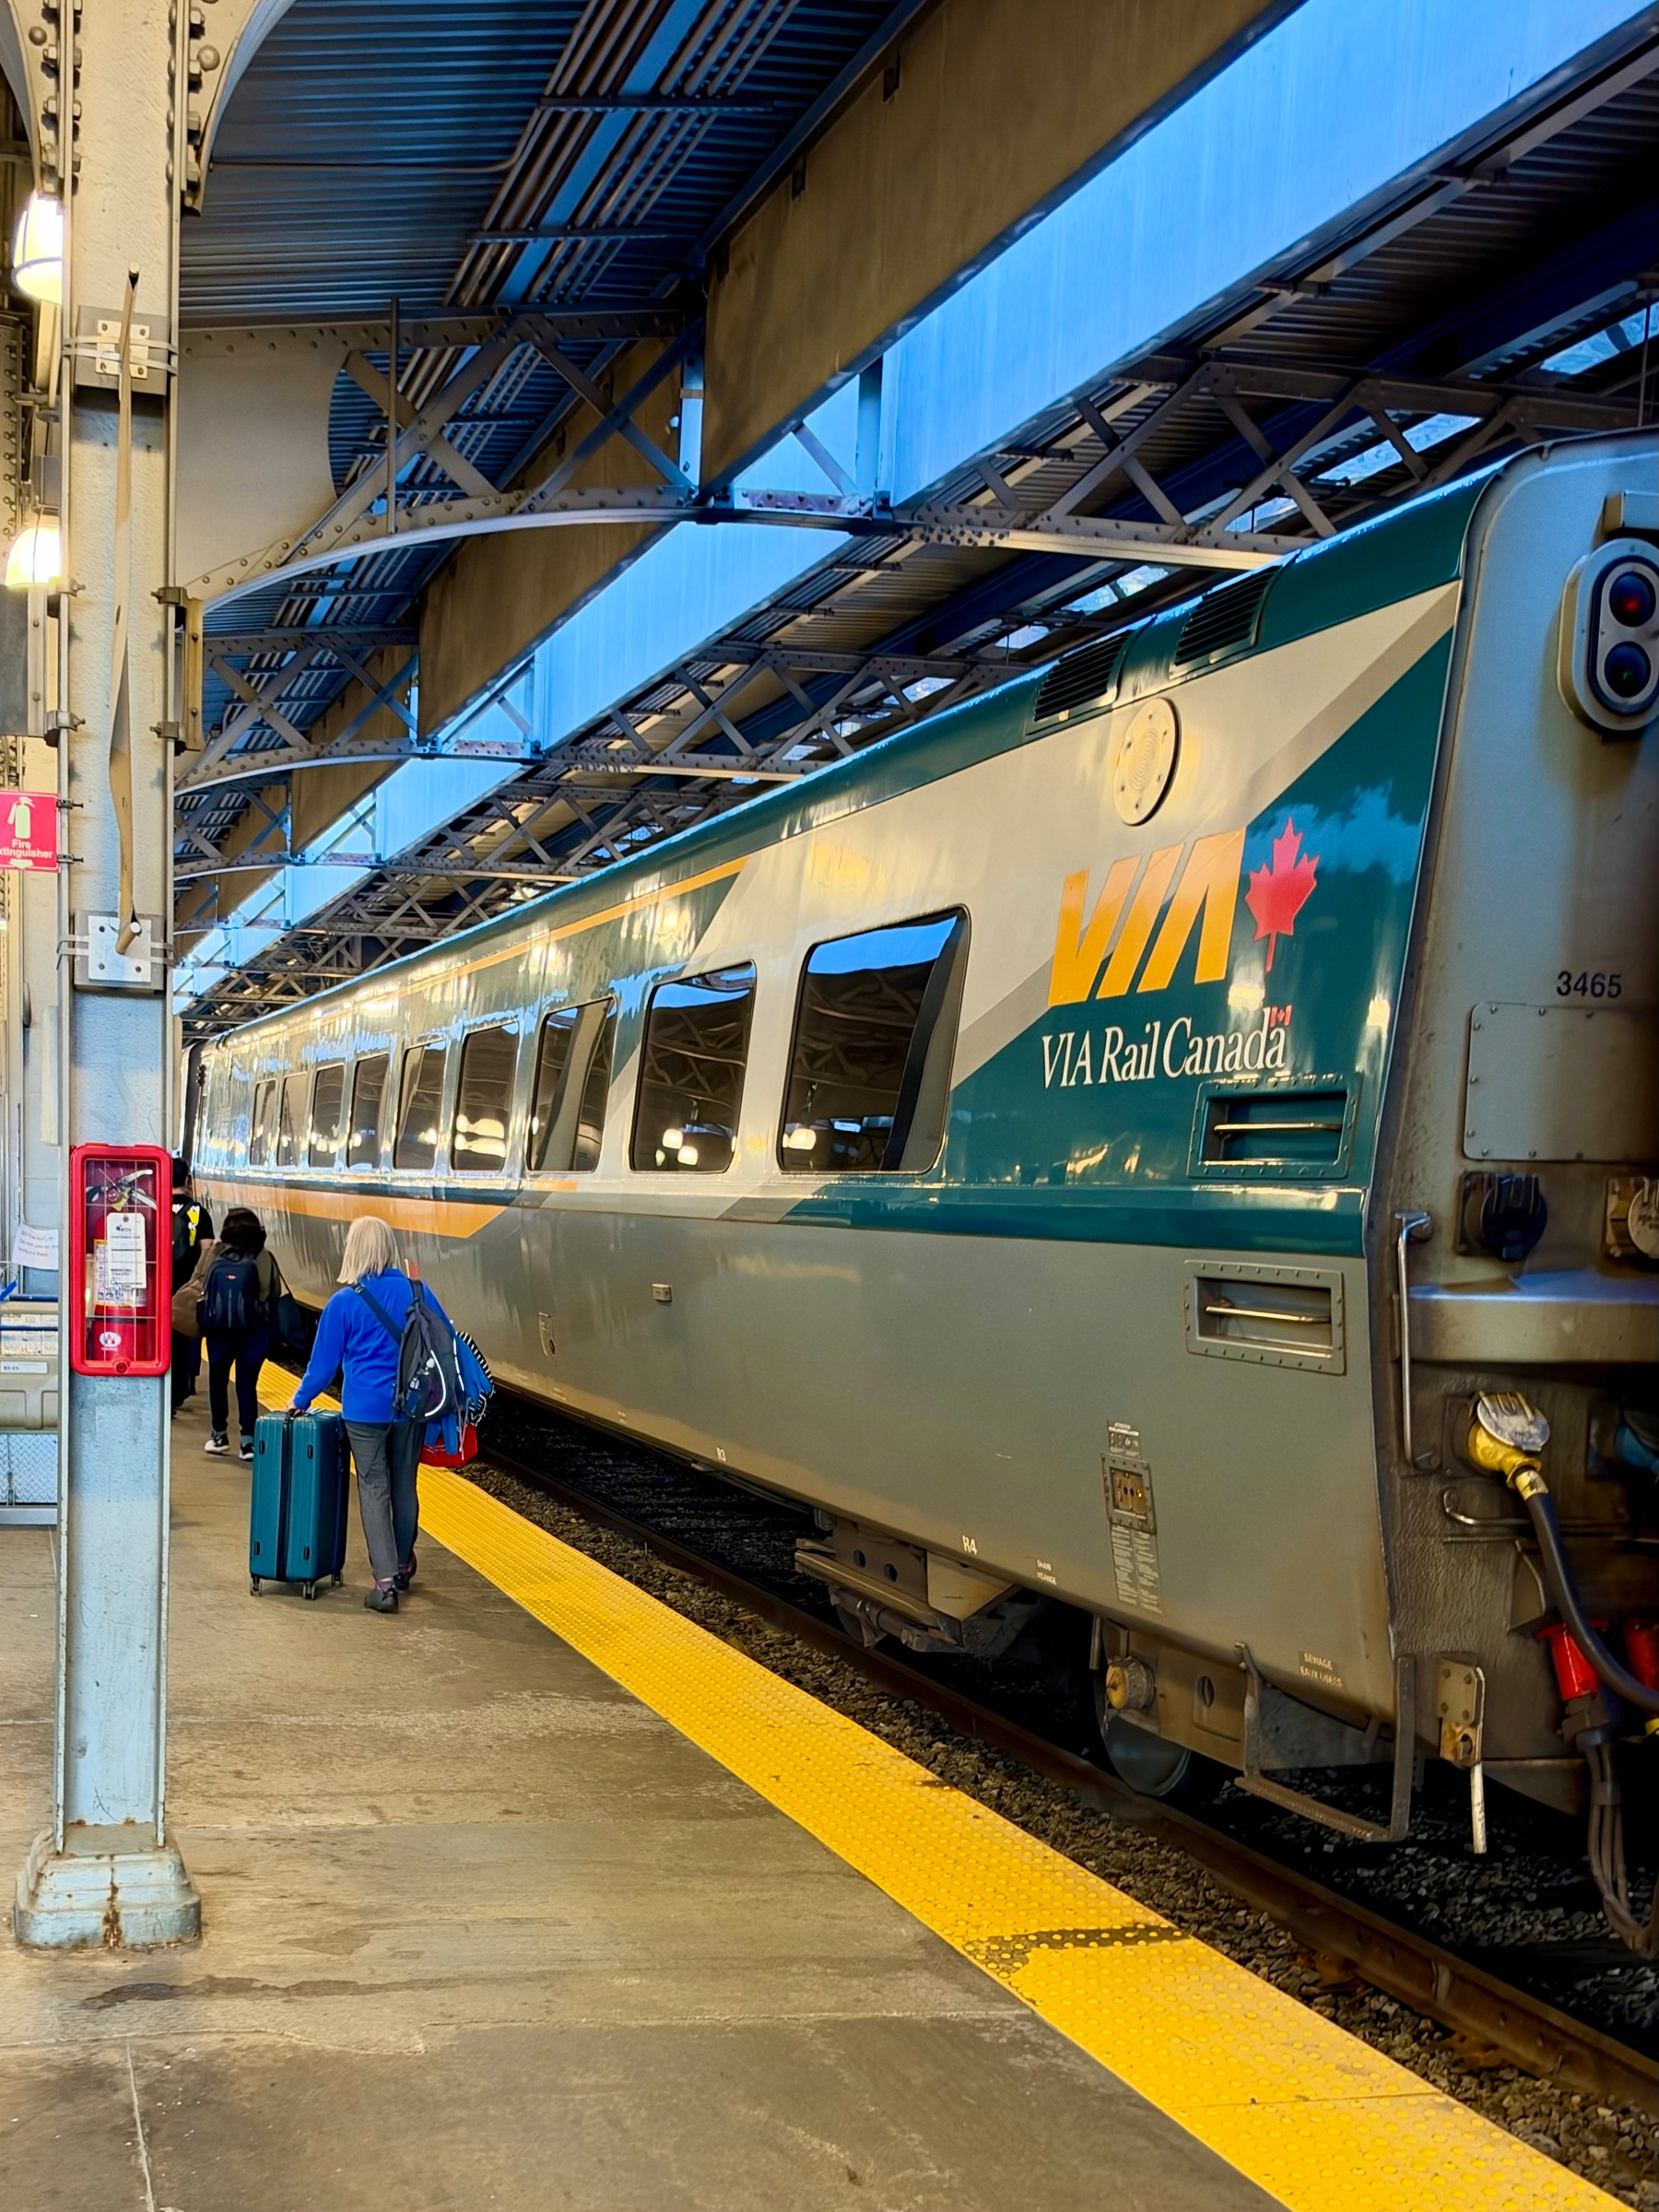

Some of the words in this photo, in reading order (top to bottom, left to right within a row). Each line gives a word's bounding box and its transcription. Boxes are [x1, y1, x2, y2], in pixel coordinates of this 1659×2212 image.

[12, 839, 31, 849] Fire
[1047, 826, 1246, 1007] VIA
[1557, 971, 1622, 999] 3465
[1041, 1030, 1093, 1088] VIA
[1098, 1020, 1160, 1084] Rail
[1162, 1006, 1287, 1078] Canada
[962, 1535, 978, 1556] R4
